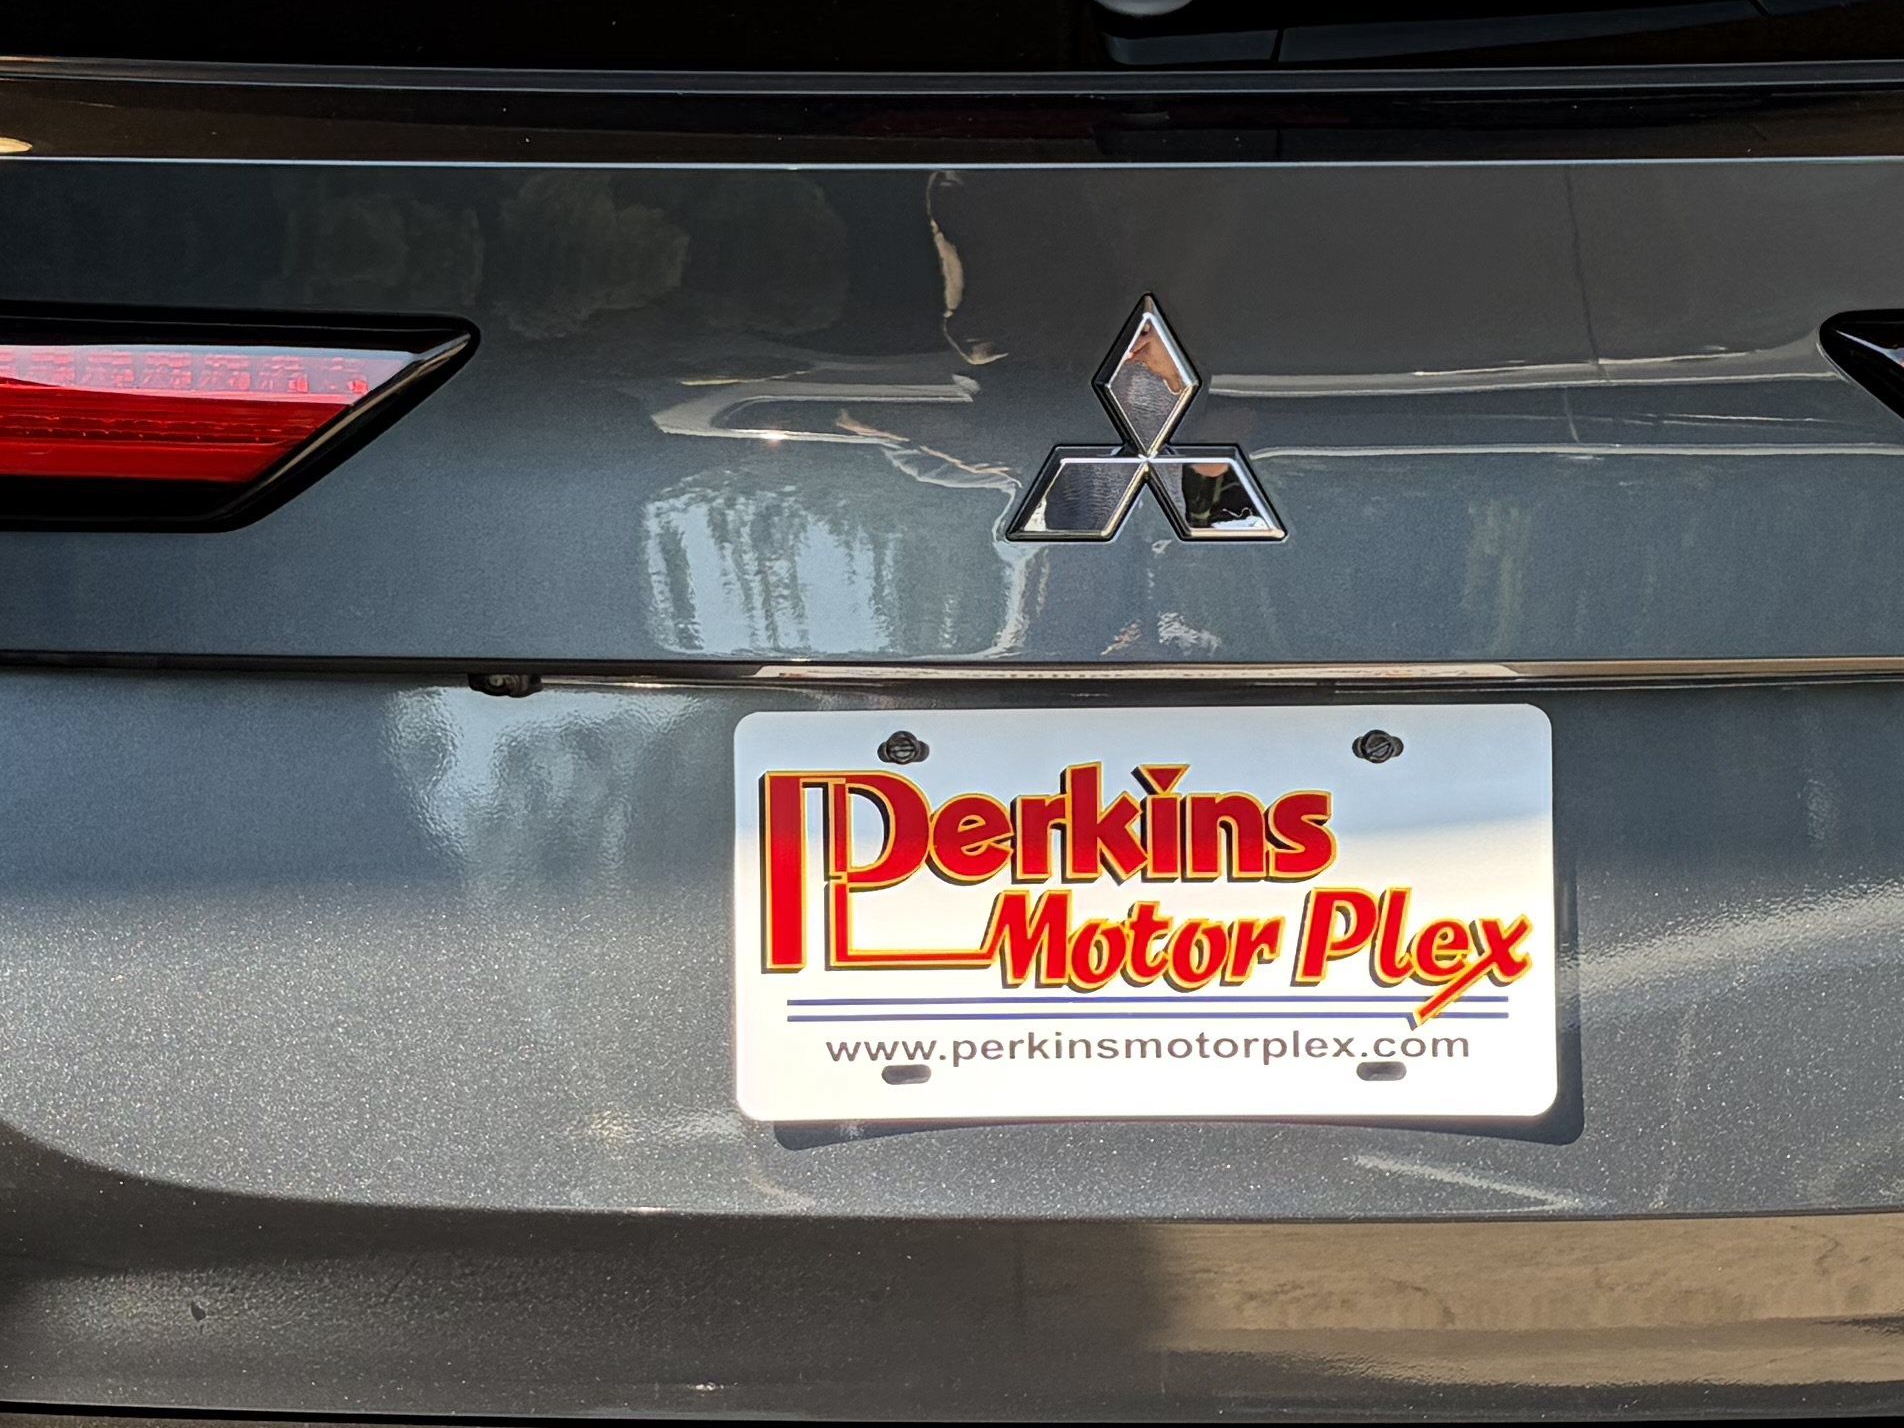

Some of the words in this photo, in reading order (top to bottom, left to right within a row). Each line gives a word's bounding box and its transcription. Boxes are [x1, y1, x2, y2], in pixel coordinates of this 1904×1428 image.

[760, 761, 1337, 972] Perkins
[986, 888, 1285, 992] Motor
[1292, 886, 1533, 1029] Plex
[826, 1029, 1470, 1066] www.perkinsmotorplex.com
